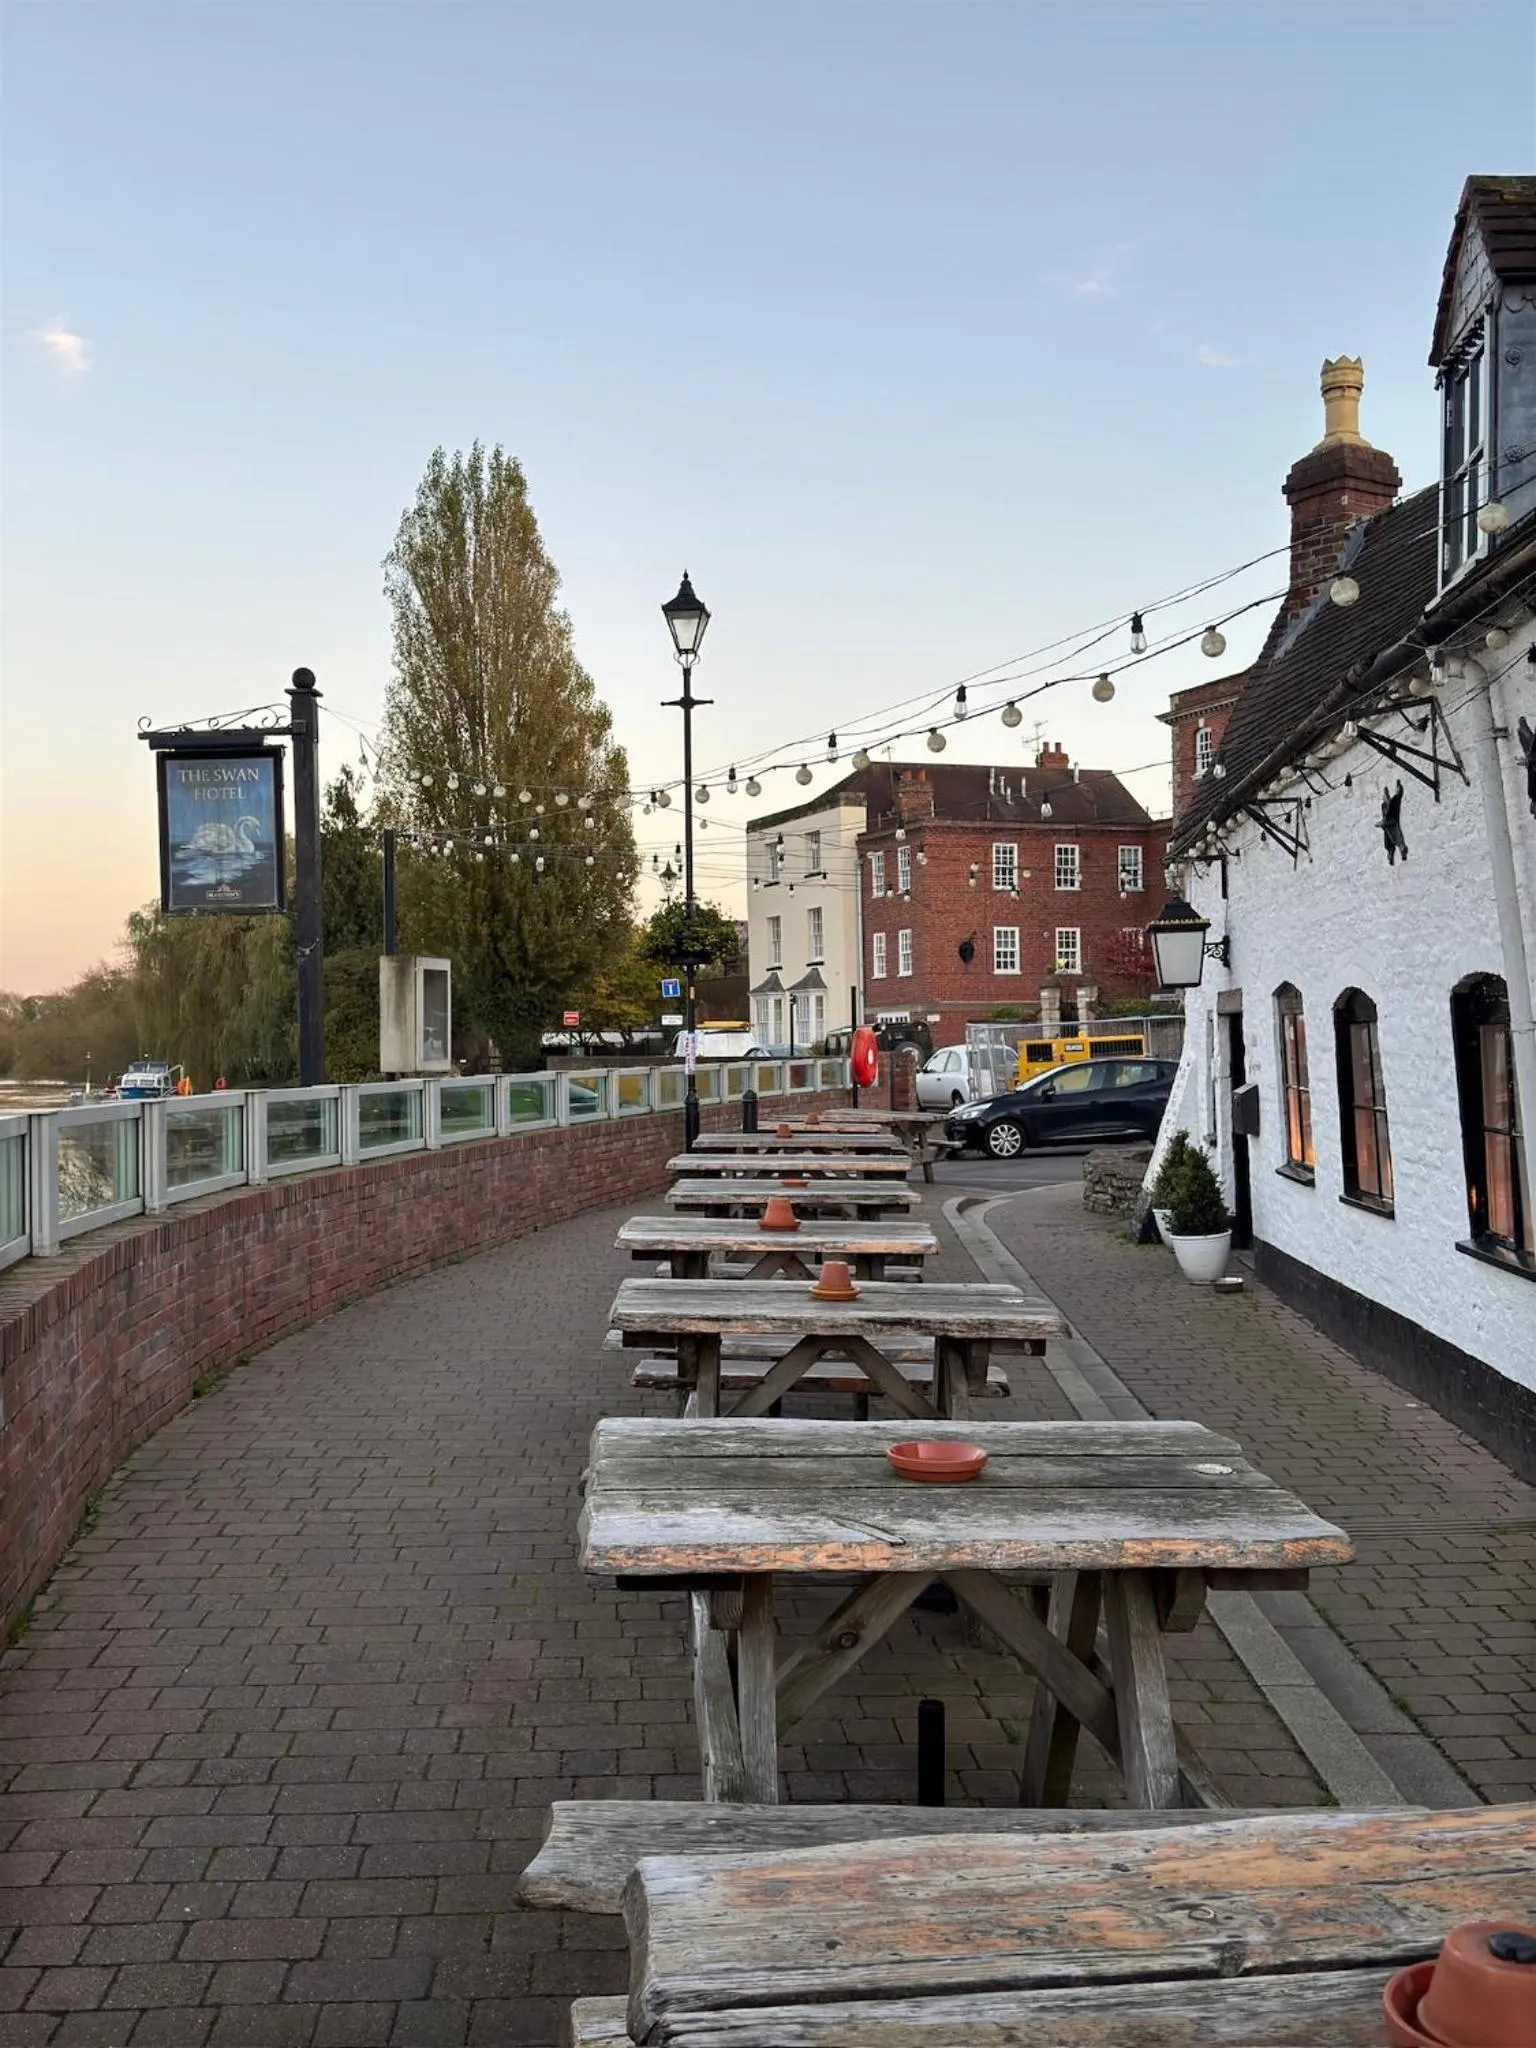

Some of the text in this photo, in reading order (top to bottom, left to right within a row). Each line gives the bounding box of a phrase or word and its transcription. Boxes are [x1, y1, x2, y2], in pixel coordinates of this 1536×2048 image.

[178, 767, 259, 782] THE SWAN
[194, 787, 245, 801] HOTEL
